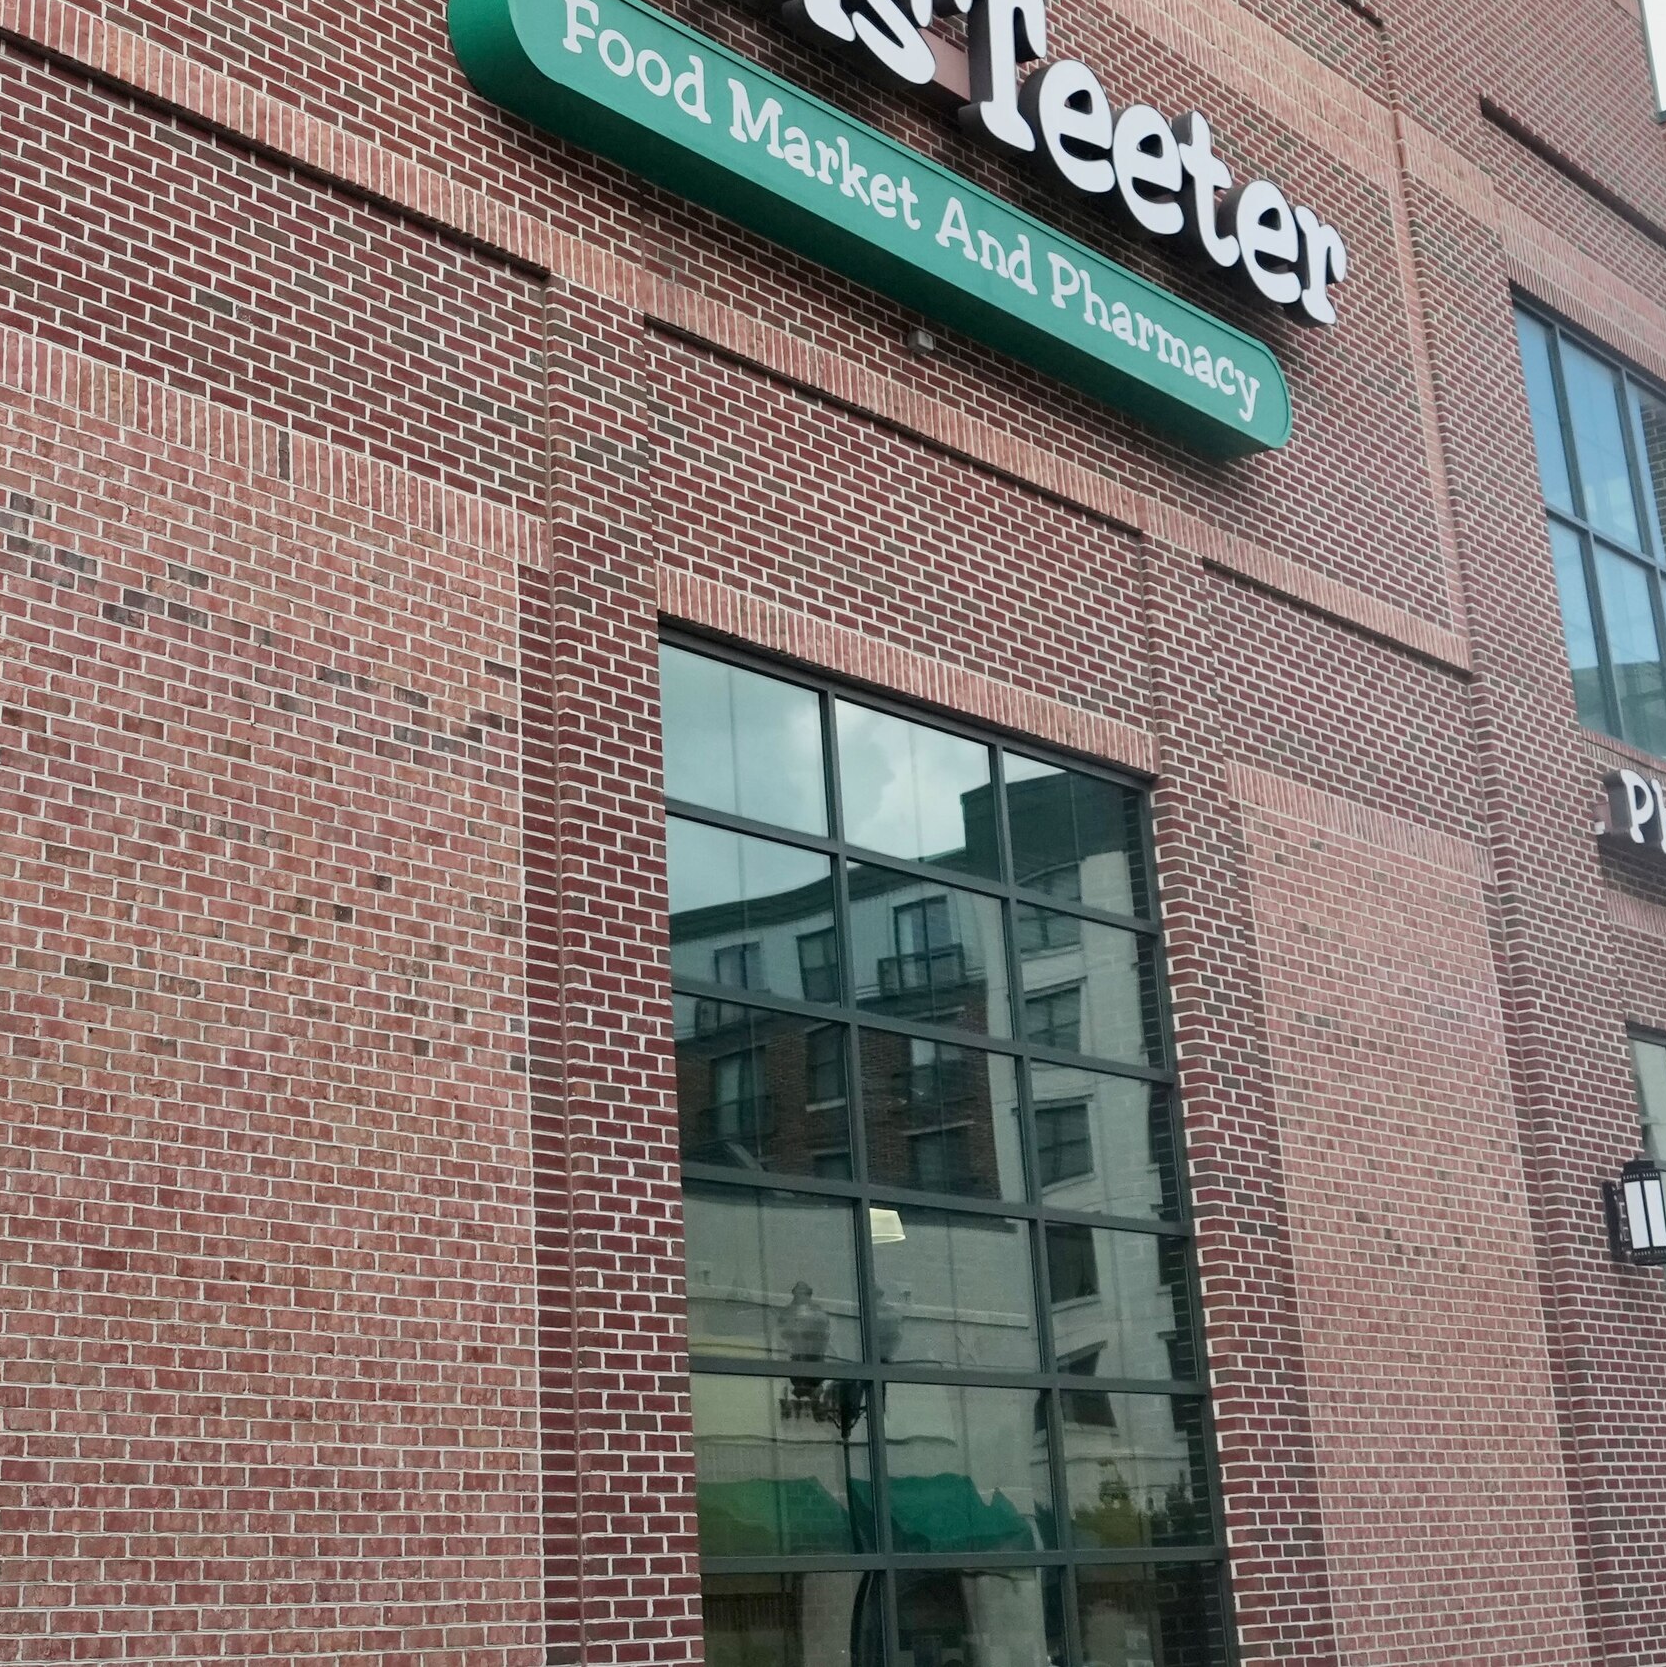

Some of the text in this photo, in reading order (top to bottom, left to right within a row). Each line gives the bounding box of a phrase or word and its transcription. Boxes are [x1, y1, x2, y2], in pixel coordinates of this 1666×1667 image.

[727, 77, 922, 232] Market
[935, 196, 1039, 296] And
[1047, 252, 1262, 423] Pharmacy
